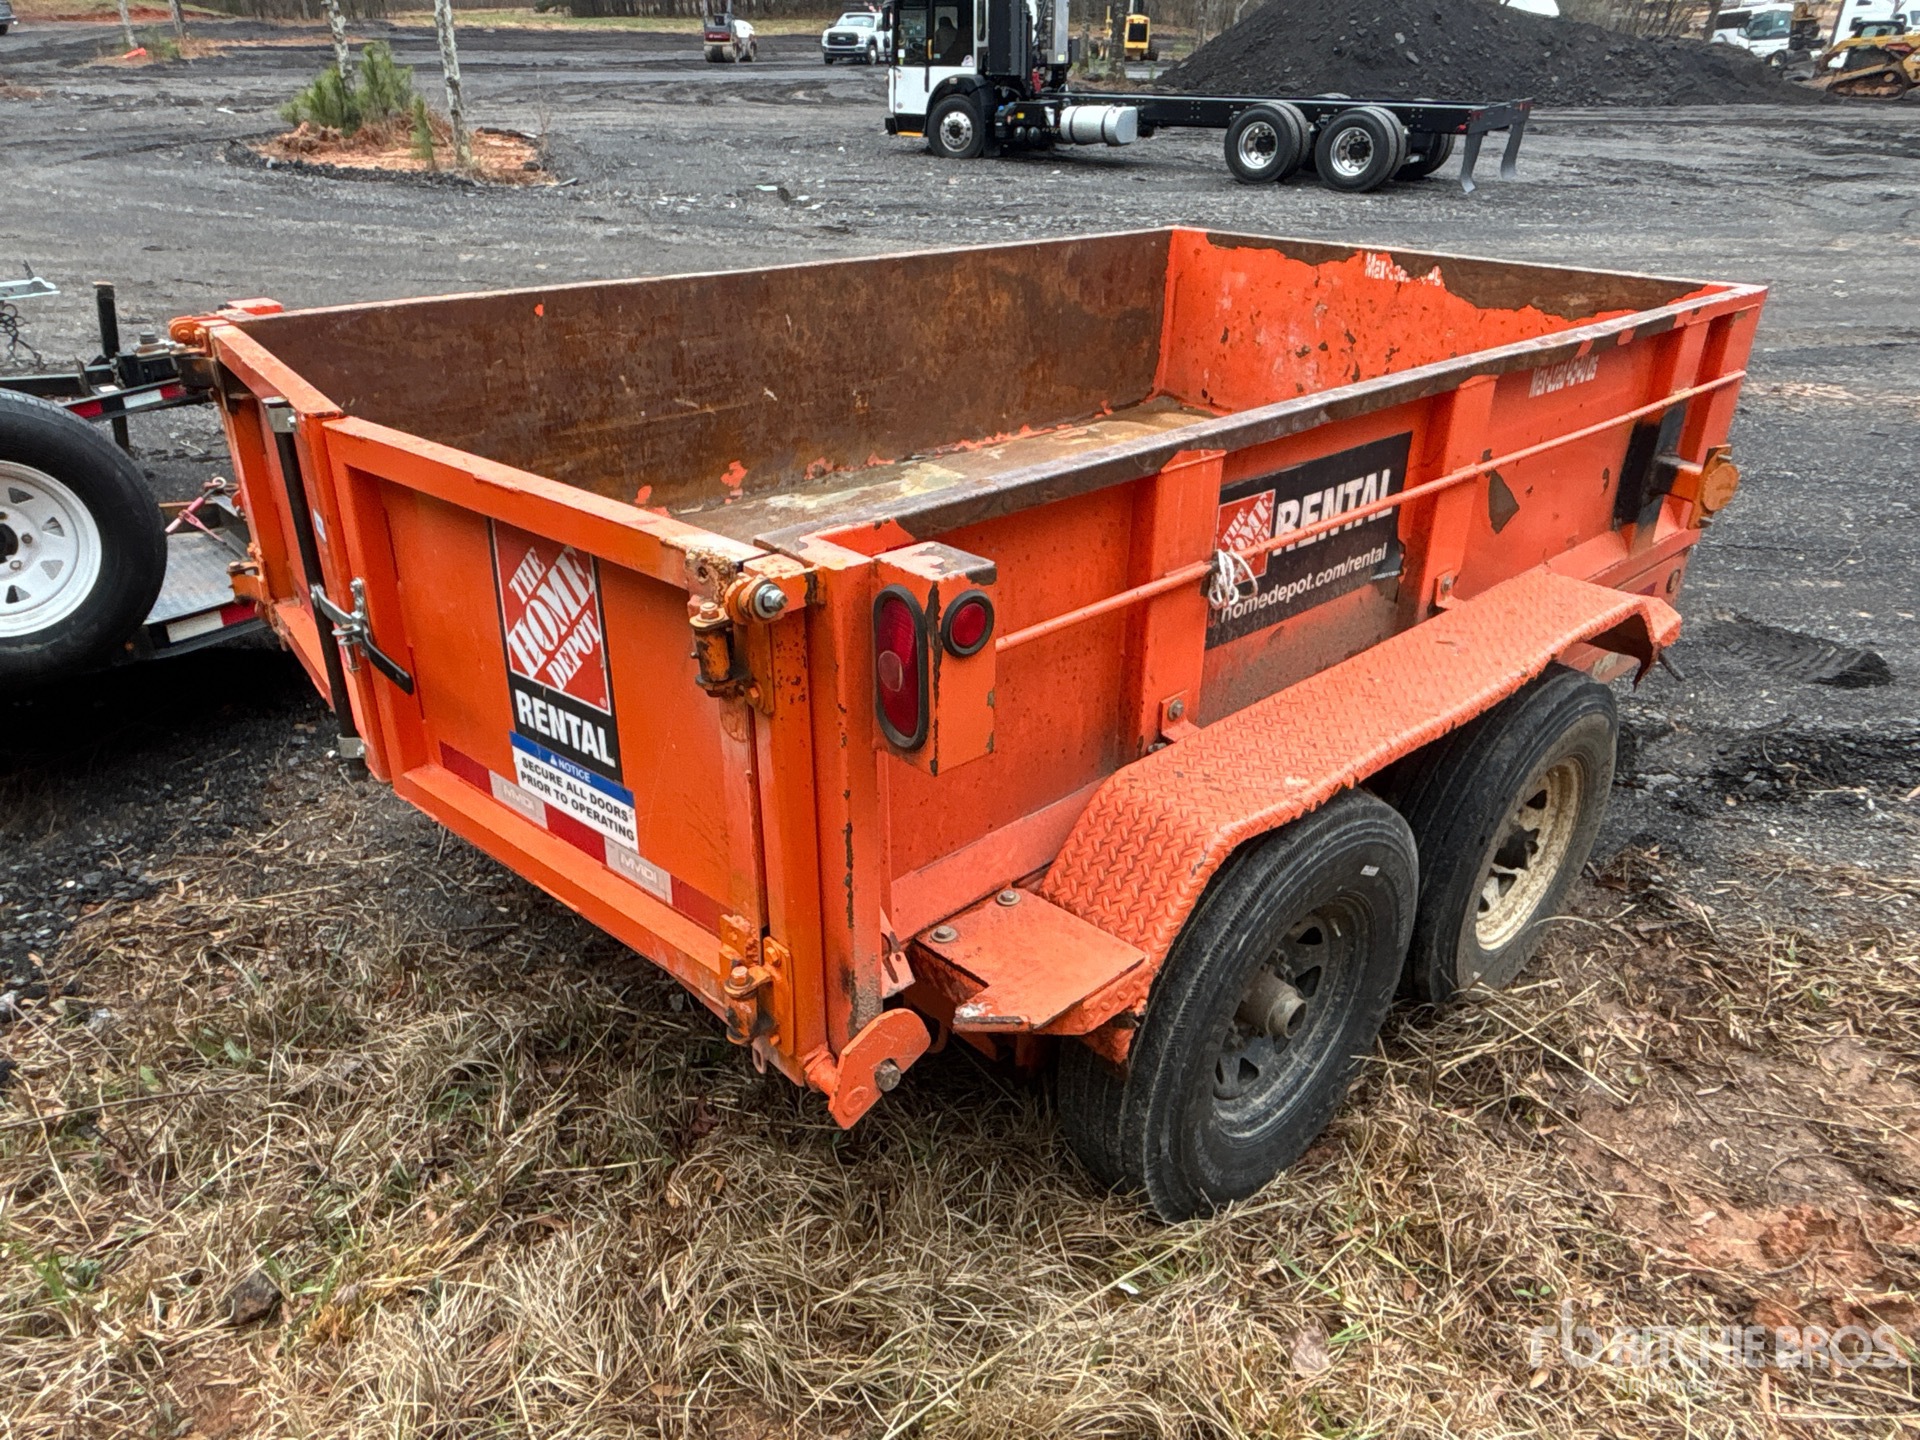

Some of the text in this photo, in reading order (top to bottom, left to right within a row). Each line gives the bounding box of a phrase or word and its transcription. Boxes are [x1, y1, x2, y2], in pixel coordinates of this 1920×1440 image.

[1273, 469, 1392, 556] RENTAL
[506, 545, 595, 679] HOME
[509, 547, 546, 604] THE
[546, 610, 600, 690] DEPOT
[515, 689, 616, 768] RENTAL
[520, 771, 635, 841] PRIOR TO OPERATING
[522, 757, 628, 822] SECURE ALL DOORS
[558, 759, 591, 783] NOTICE
